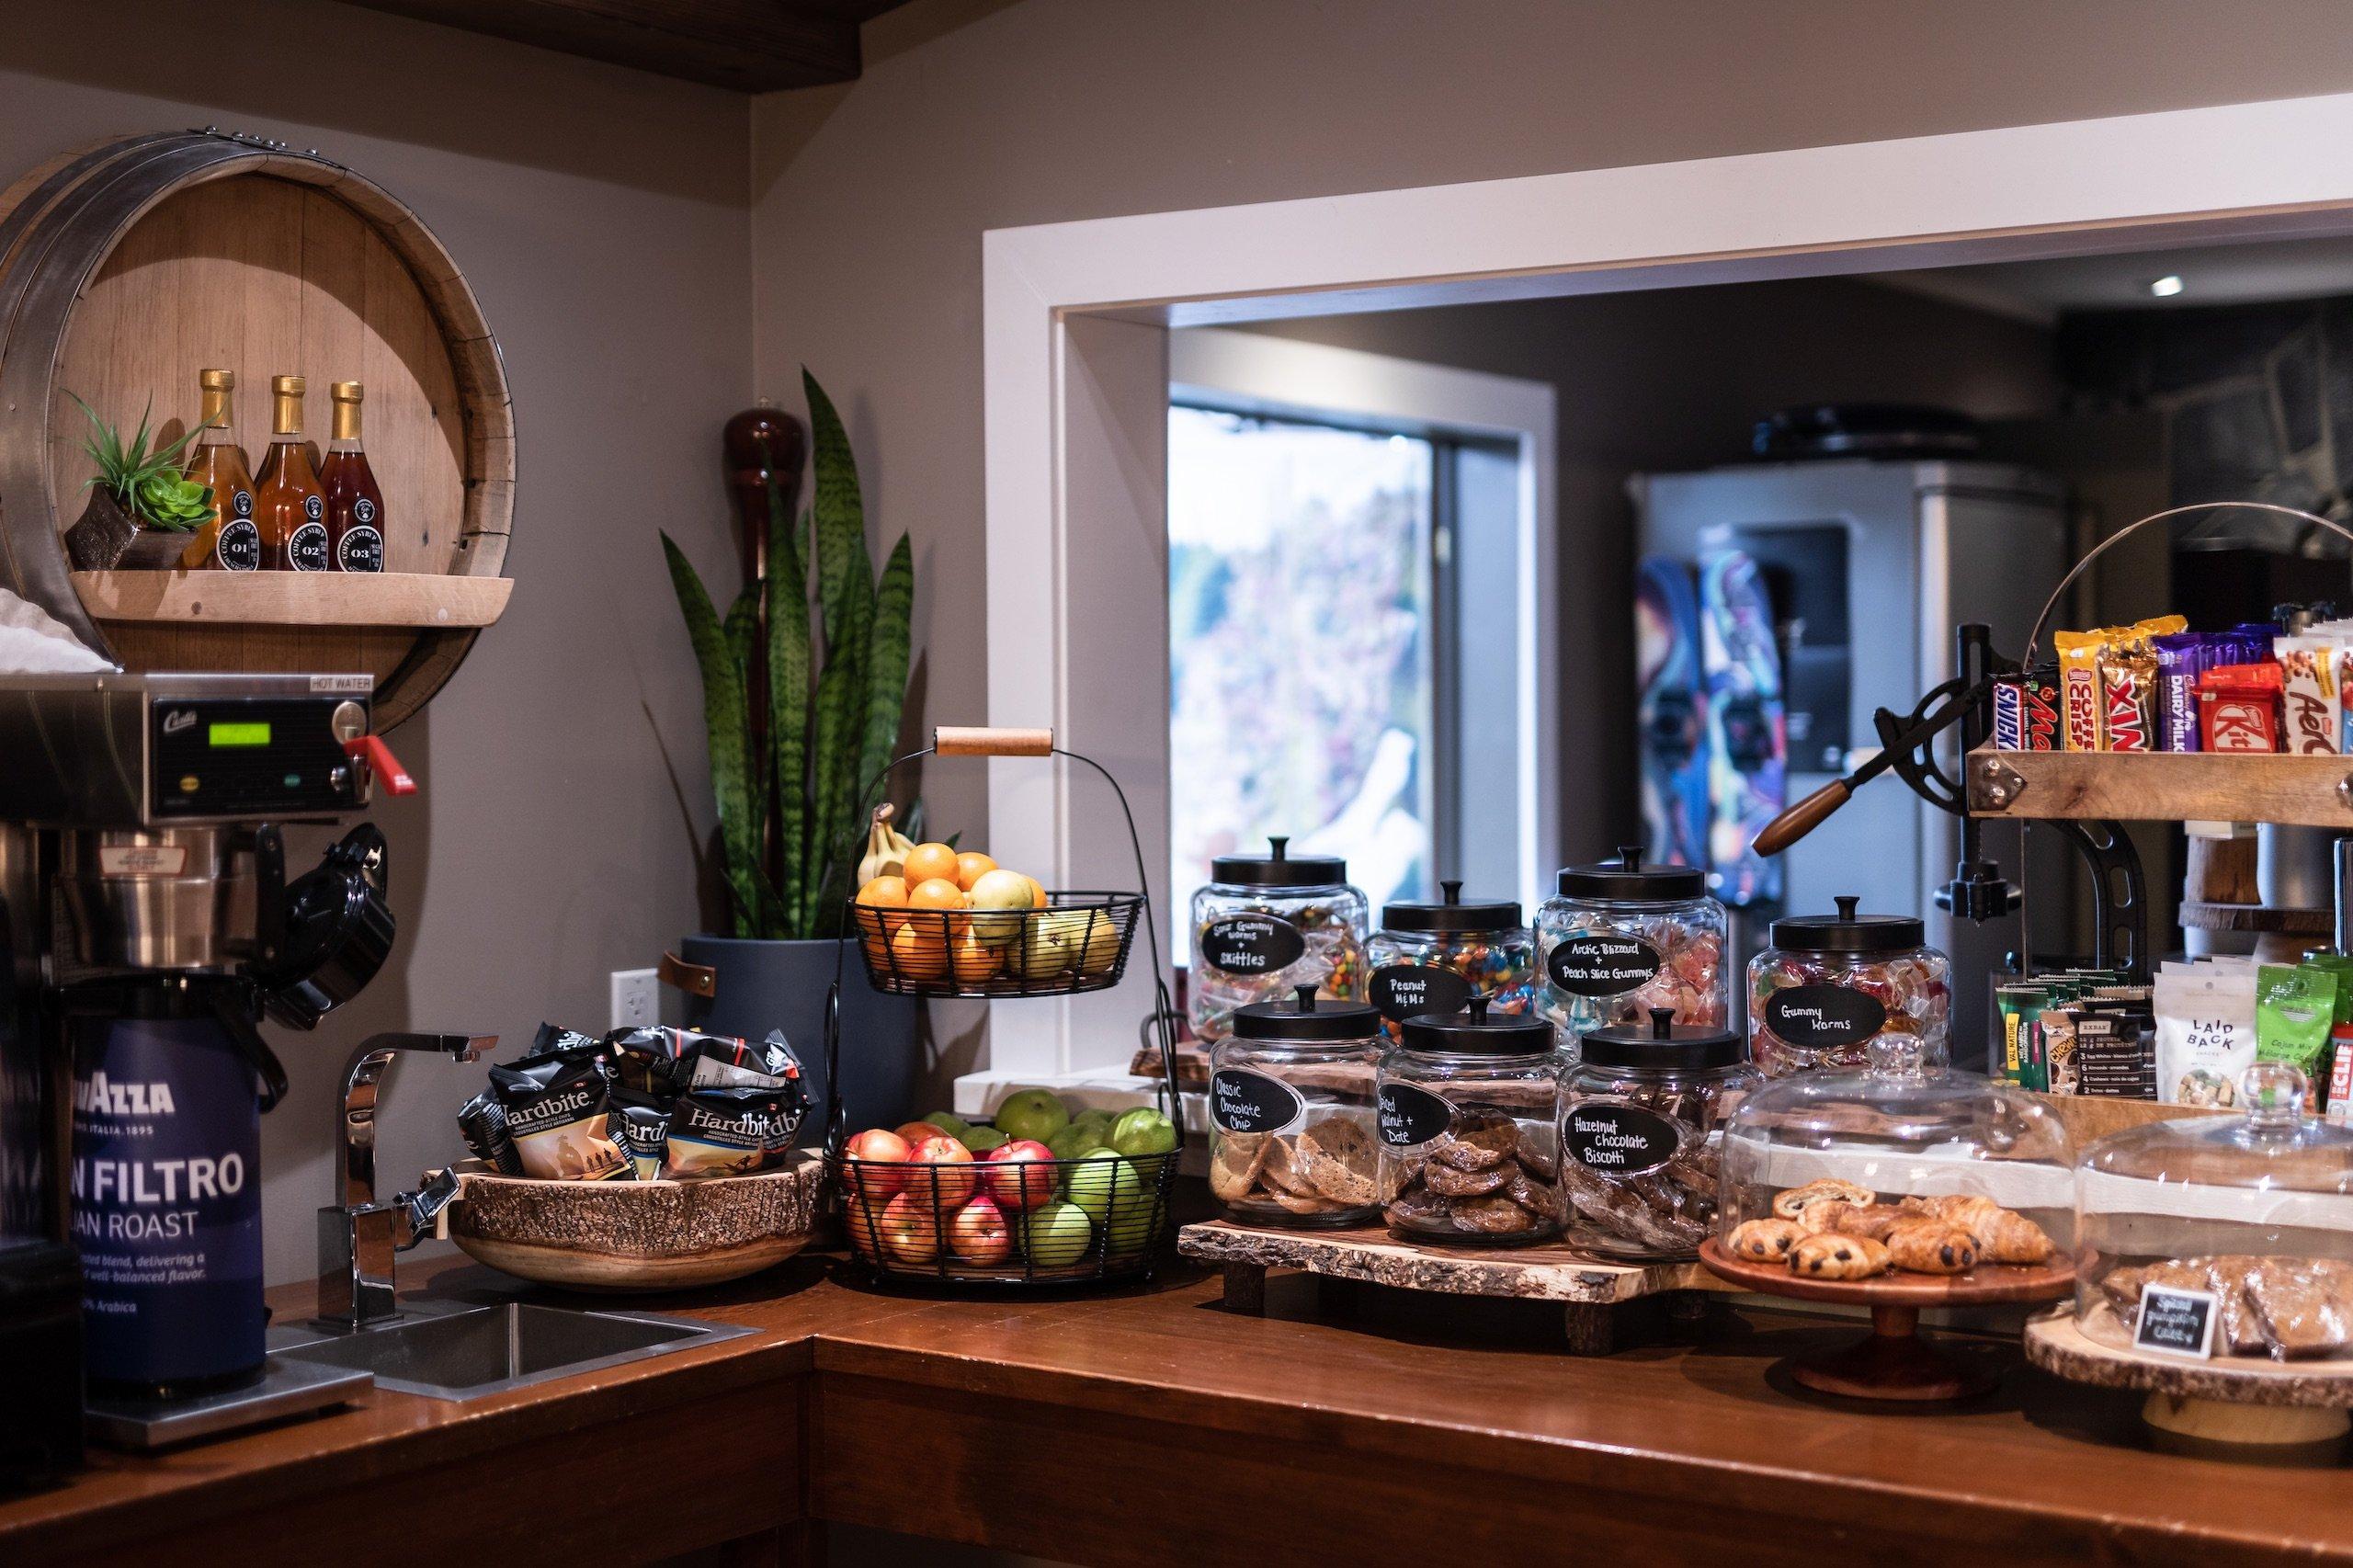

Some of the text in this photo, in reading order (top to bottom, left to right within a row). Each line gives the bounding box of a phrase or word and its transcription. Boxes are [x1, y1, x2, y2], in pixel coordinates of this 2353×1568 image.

[221, 527, 237, 554] COFFEE
[236, 524, 255, 534] SYRUP
[292, 528, 308, 557] COFFEE
[341, 533, 356, 560] COFFEE
[357, 530, 378, 540] SYRUP
[231, 543, 248, 553] 01
[301, 546, 319, 556] 02
[350, 549, 369, 559] 03
[311, 677, 371, 690] HOT WATER
[2171, 675, 2184, 719] DAIRY
[2069, 683, 2084, 748] CRISP
[2172, 719, 2186, 752] MILK
[1236, 921, 1274, 936] Gummy
[1572, 942, 1640, 955] Arctic Blizzard
[1563, 965, 1654, 981] Peach Slice Gummys
[1390, 978, 1427, 991] Peanut
[1781, 1005, 1822, 1020] Gummy
[1812, 1018, 1851, 1030] Worms
[2193, 1019, 2234, 1034] LAID
[2188, 1034, 2234, 1051] BACK
[2008, 1047, 2017, 1063] VAL
[2332, 1043, 2353, 1086] CLIF
[1216, 1077, 1242, 1097] Classic
[1221, 1096, 1261, 1118] Chocolate
[126, 1124, 154, 1135] 1895
[688, 1108, 769, 1137] Hardbit
[1574, 1117, 1618, 1135] Hazelnut
[1386, 1129, 1410, 1143] Date
[1584, 1147, 1625, 1165] Biscotti
[94, 1153, 244, 1203] FILTRO
[108, 1210, 199, 1239] ROAST
[136, 1253, 194, 1267] delivering
[197, 1253, 205, 1263] a
[91, 1270, 165, 1283] well-balanced
[167, 1268, 206, 1284] flavor.
[97, 1300, 137, 1313] Arabica
